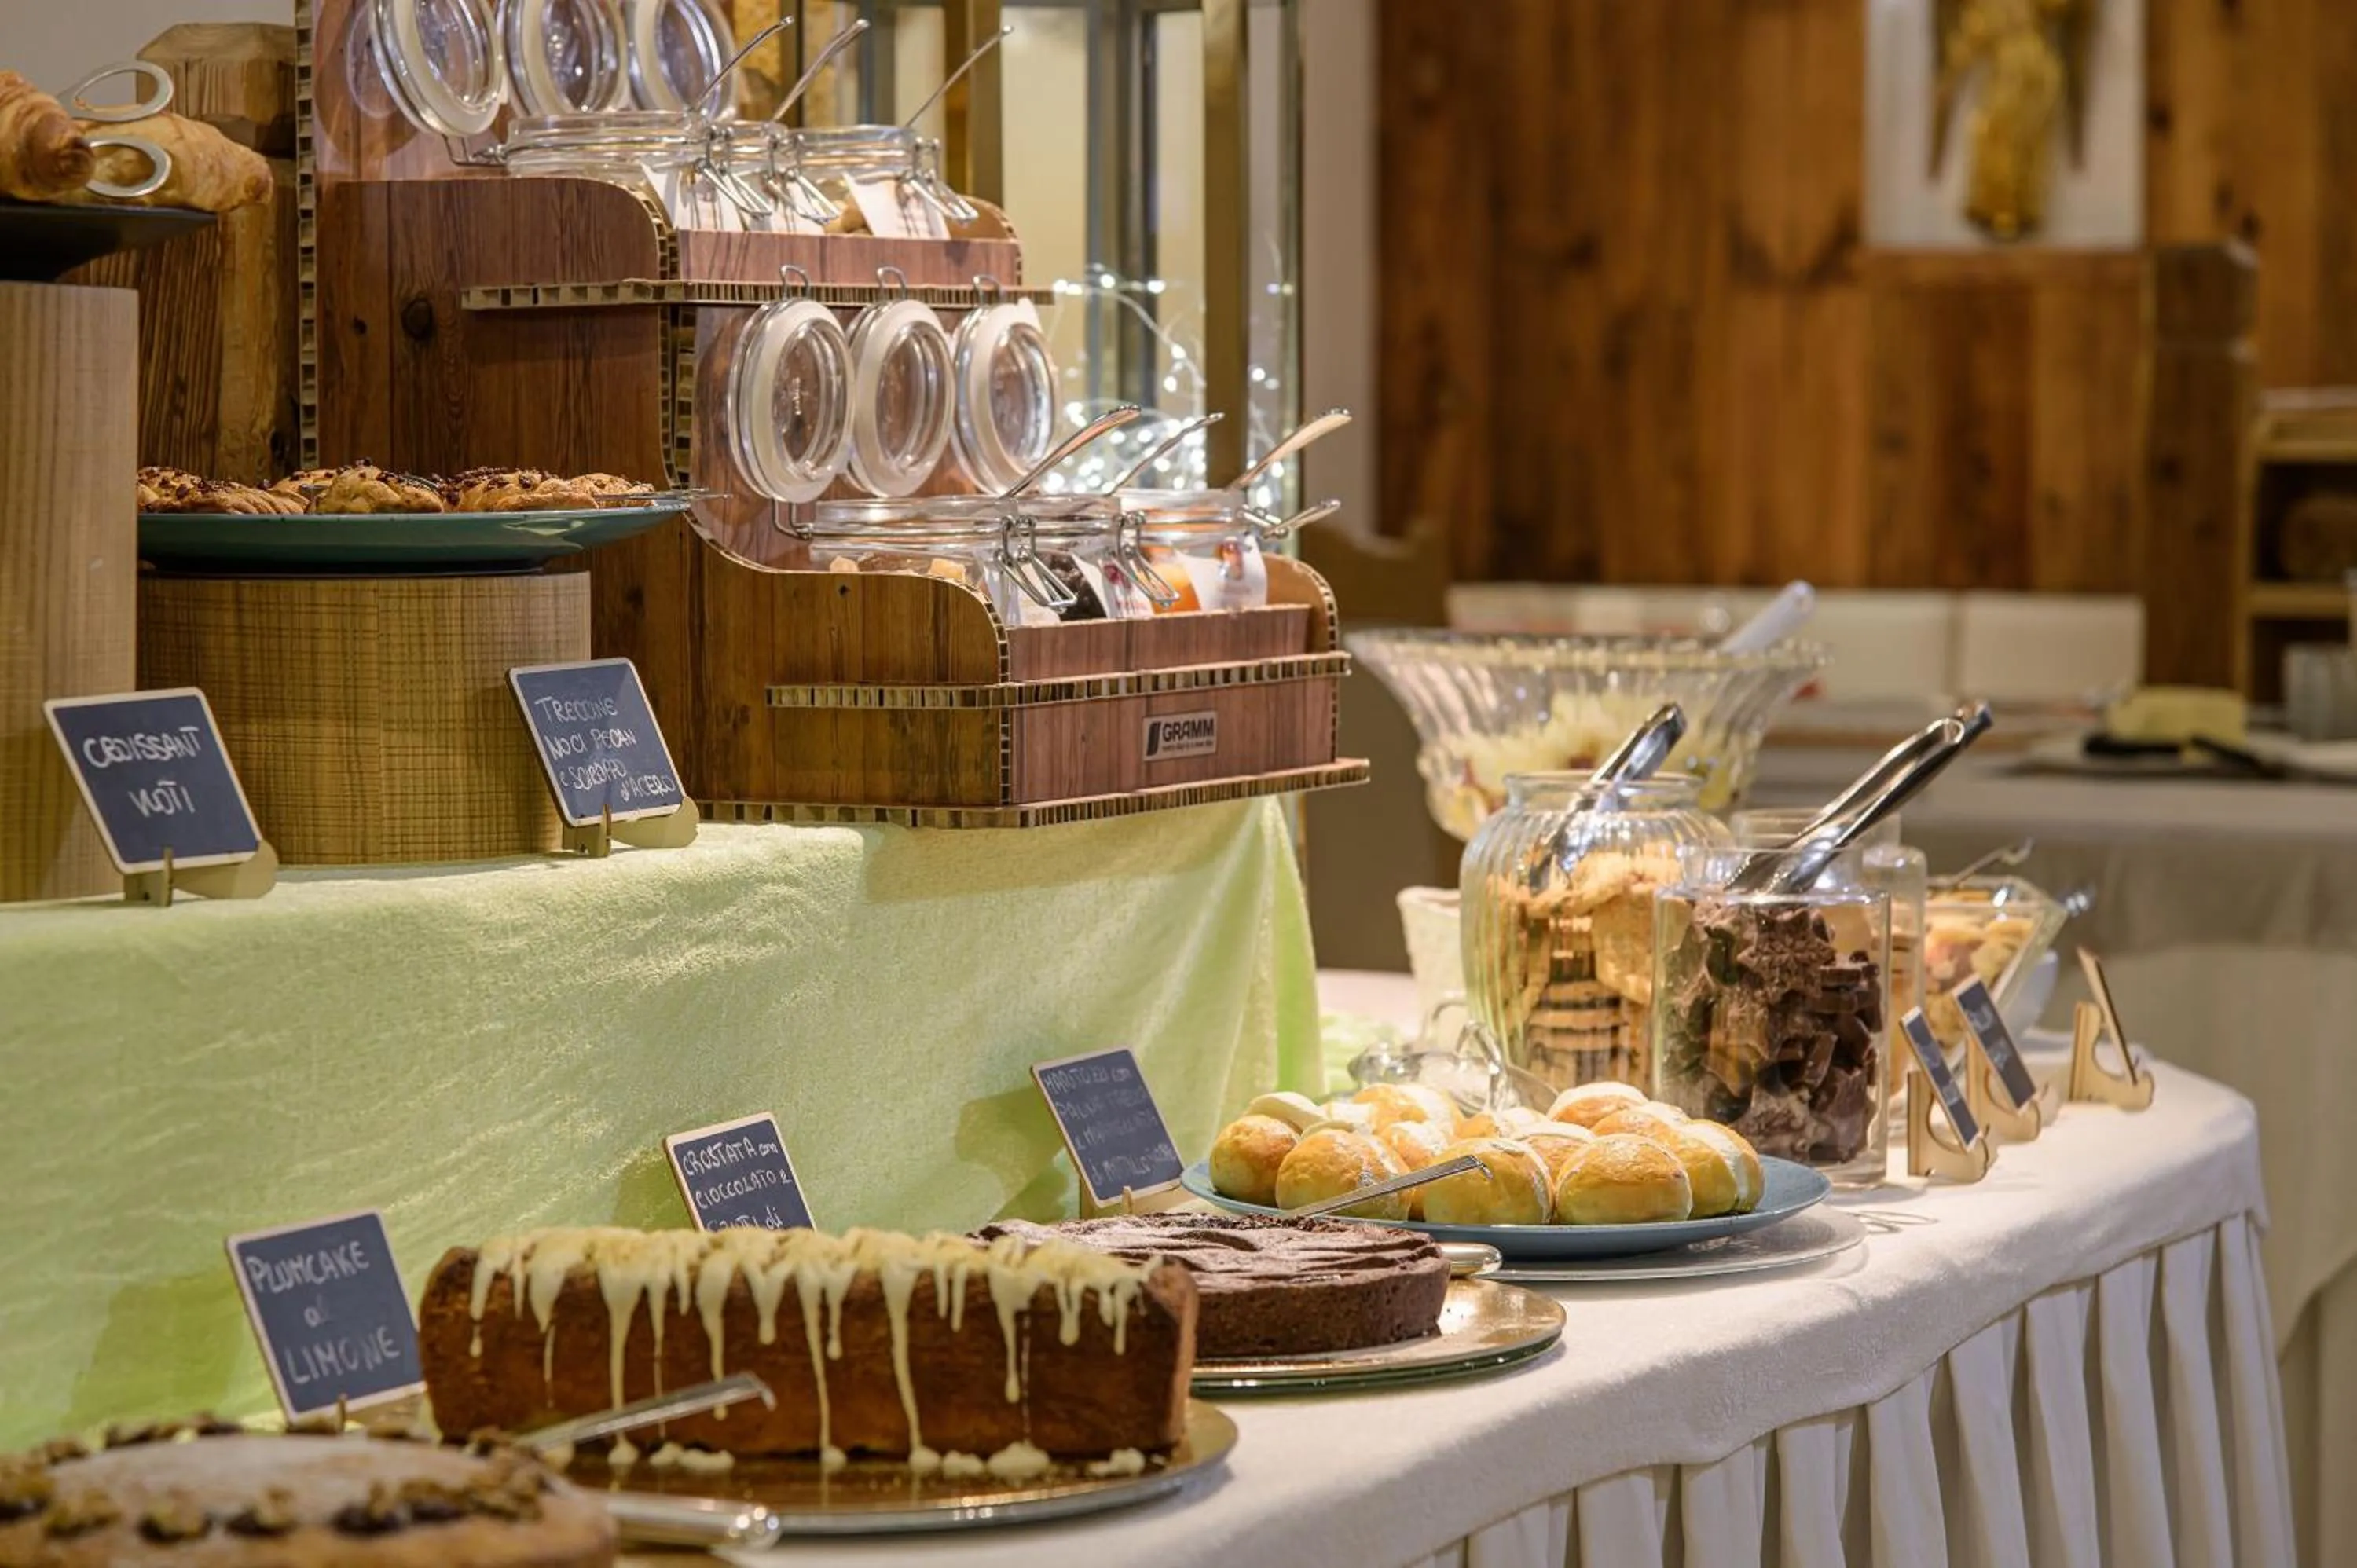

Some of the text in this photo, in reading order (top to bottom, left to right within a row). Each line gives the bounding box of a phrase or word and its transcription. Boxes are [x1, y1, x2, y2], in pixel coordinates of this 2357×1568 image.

[82, 726, 201, 768] CROISSANT
[545, 728, 638, 761] NOCI PECAN
[1162, 717, 1214, 742] GRAMM
[683, 1137, 757, 1176] CROSTATA
[696, 1169, 776, 1209] CIOCCOLATO
[245, 1240, 370, 1293] PLUMCAKE
[285, 1326, 401, 1384] LIMONE
